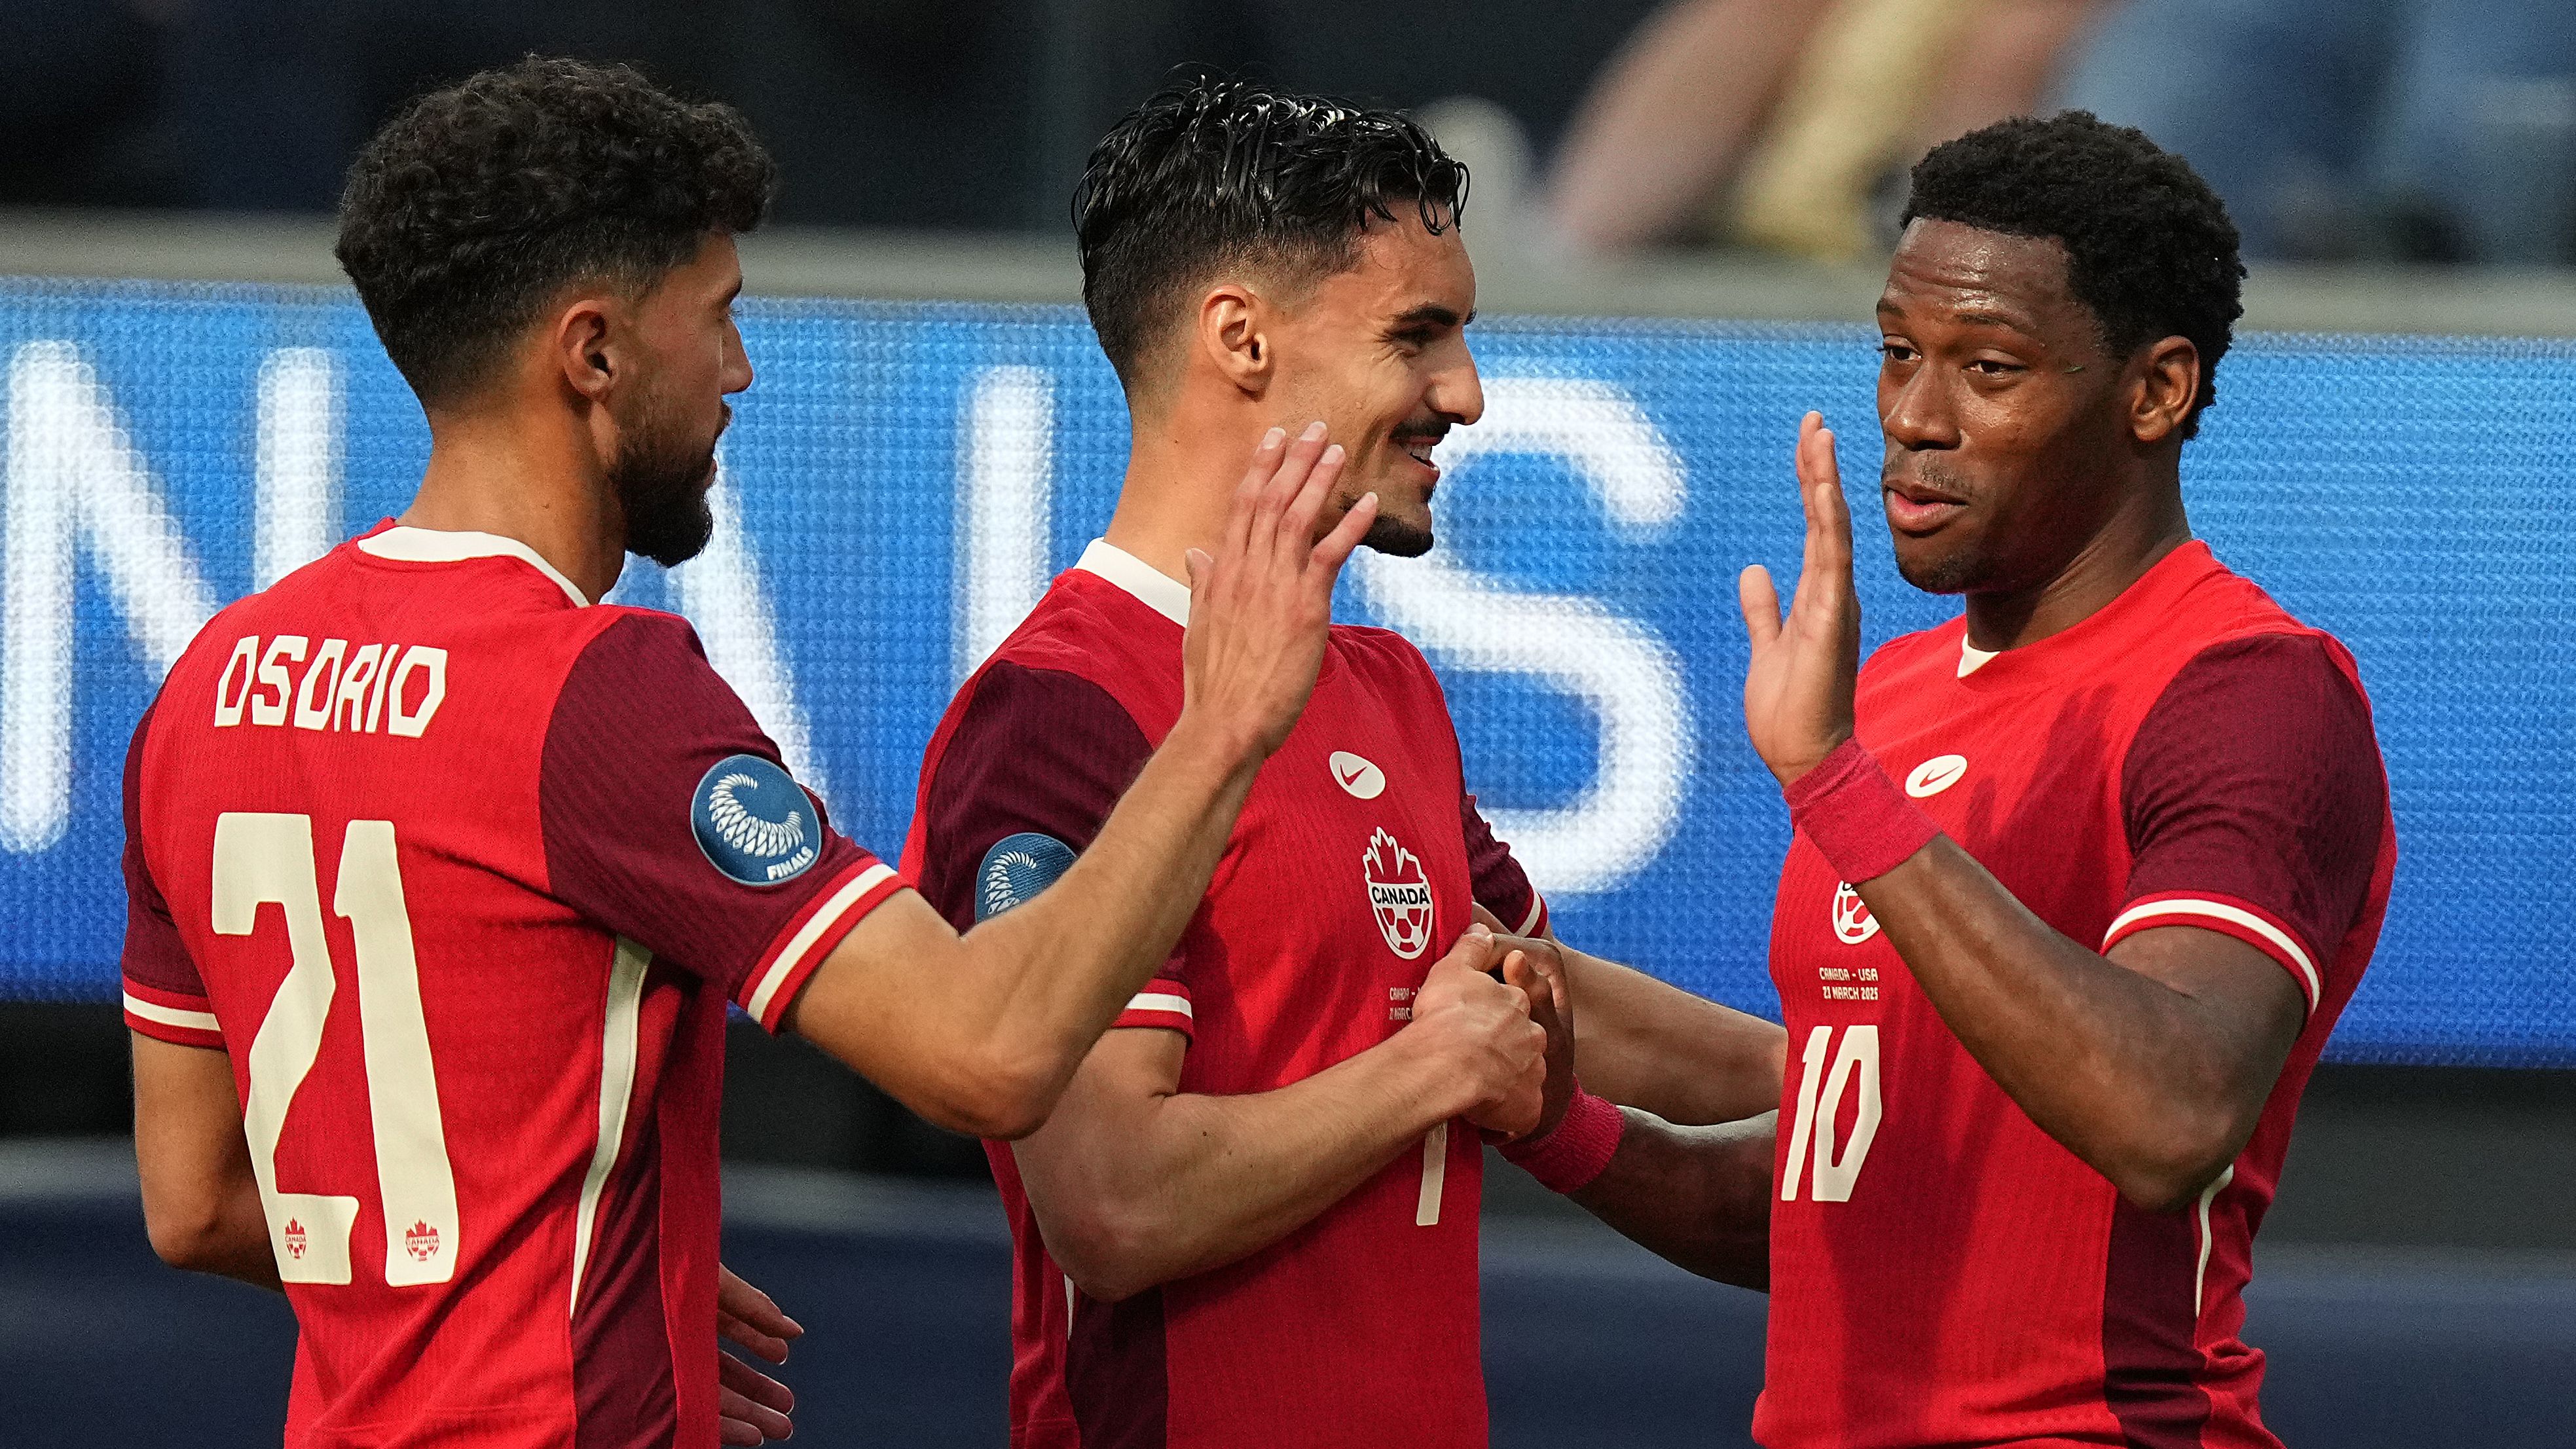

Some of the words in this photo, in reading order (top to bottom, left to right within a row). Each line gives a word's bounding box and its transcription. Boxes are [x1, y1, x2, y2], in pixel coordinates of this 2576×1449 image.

[2, 338, 1696, 894] NS
[214, 635, 448, 738] OSORIO
[767, 846, 814, 880] FINALS
[1372, 886, 1430, 905] CANADA
[1818, 967, 1850, 981] CANADA
[1858, 968, 1879, 981] USA
[1831, 986, 1860, 1000] MARCH
[1860, 987, 1879, 1000] 2025
[1394, 1007, 1412, 1021] MARC
[212, 812, 460, 1287] 21
[1781, 1025, 1882, 1202] 10
